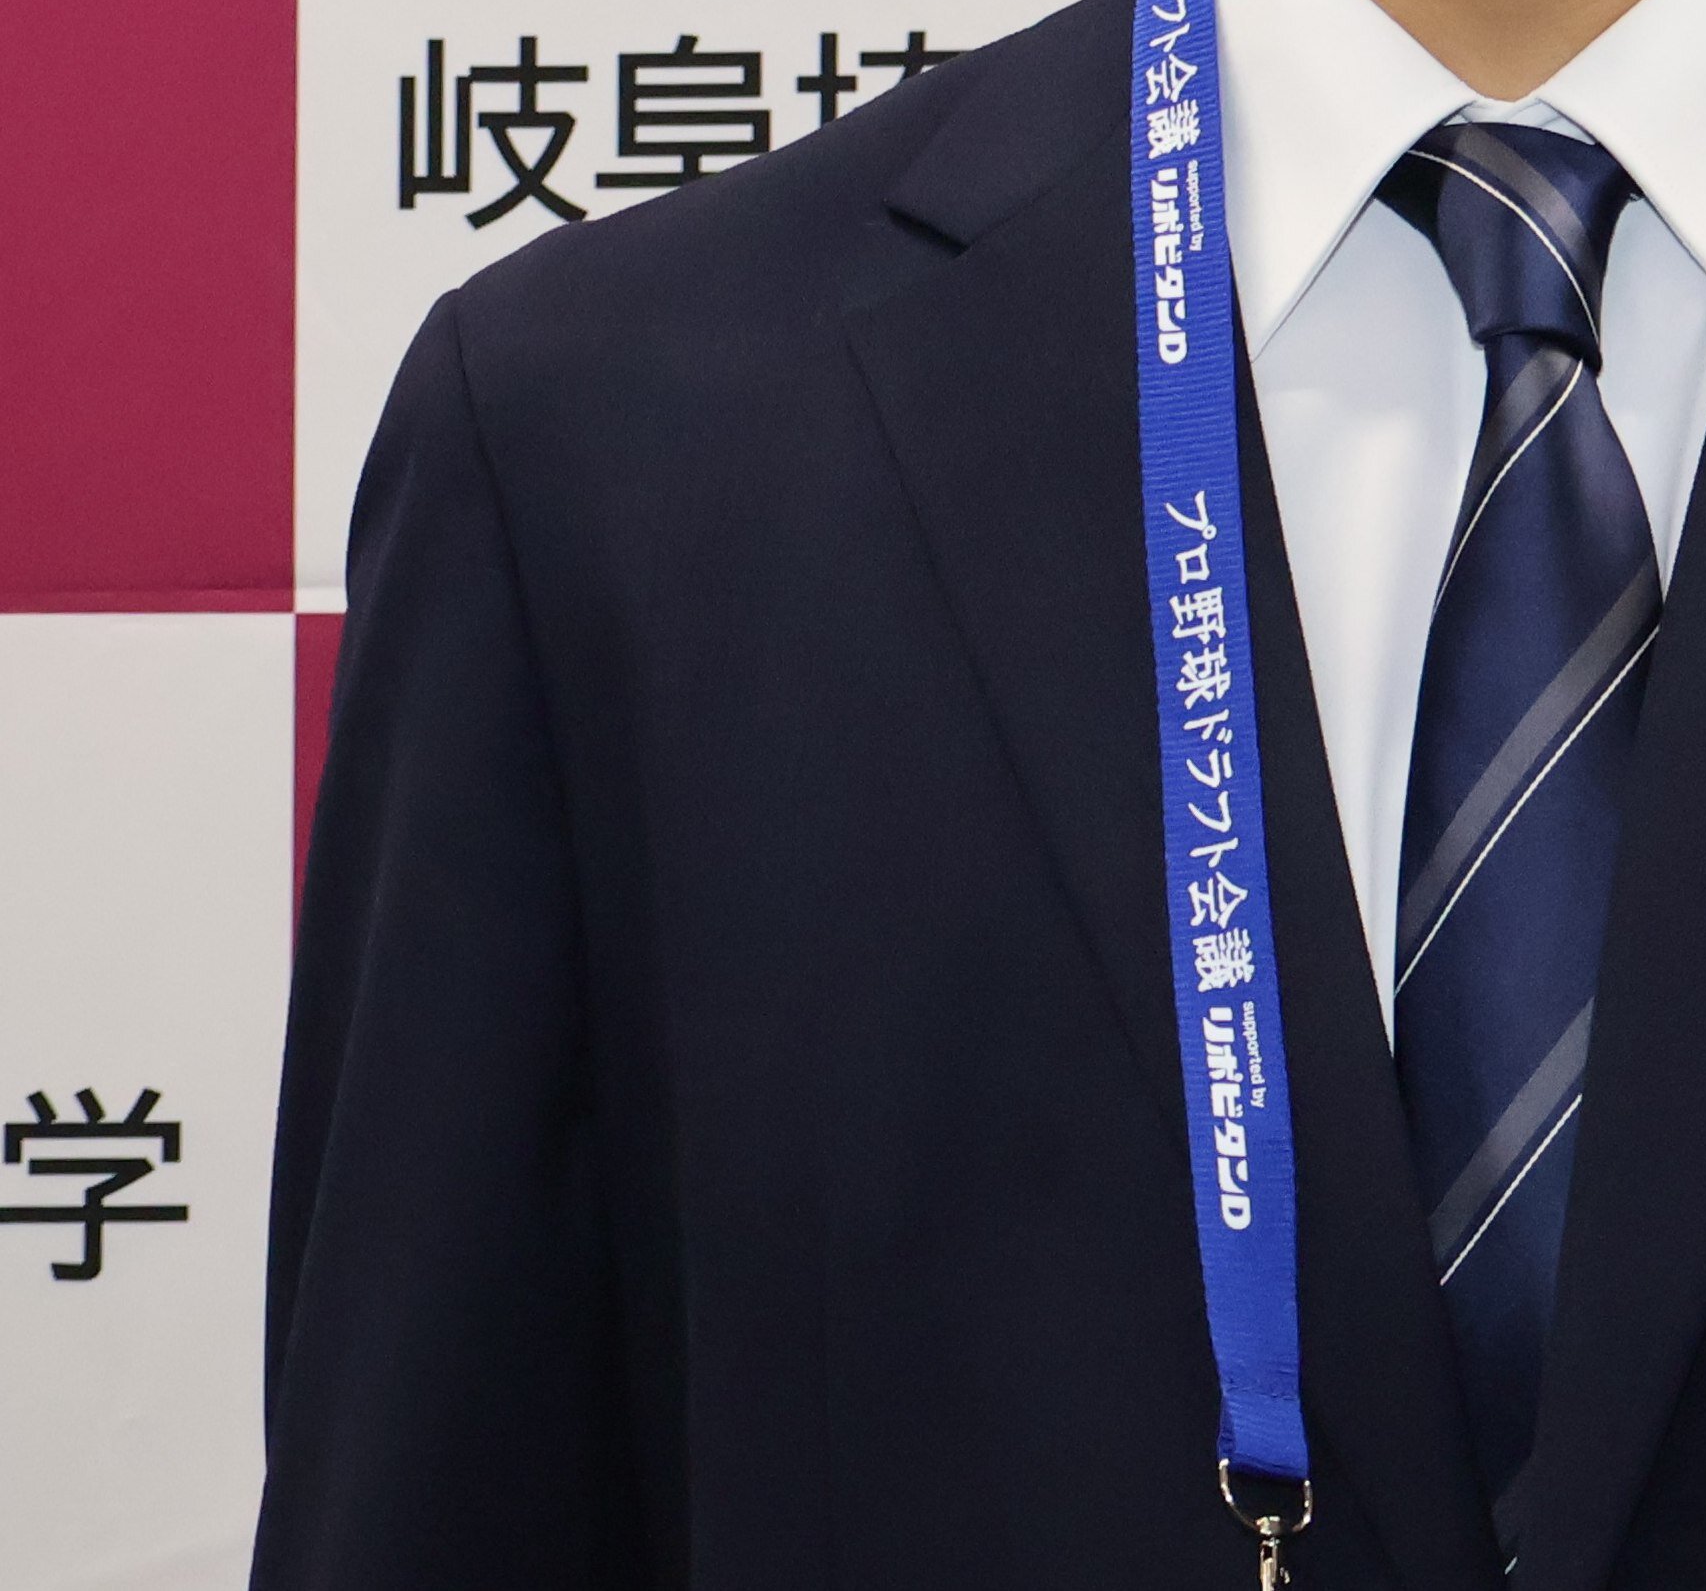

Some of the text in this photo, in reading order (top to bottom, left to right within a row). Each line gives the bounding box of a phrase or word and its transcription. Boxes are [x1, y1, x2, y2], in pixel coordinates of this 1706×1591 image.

[1151, 167, 1189, 365] リポビタンD
[1186, 159, 1204, 252] supported by
[1164, 490, 1255, 993] プロ野球ドラフト会議
[1203, 1006, 1252, 1230] リポビタンD
[1241, 1000, 1268, 1109] supported by
[0, 1087, 190, 1282] 学
